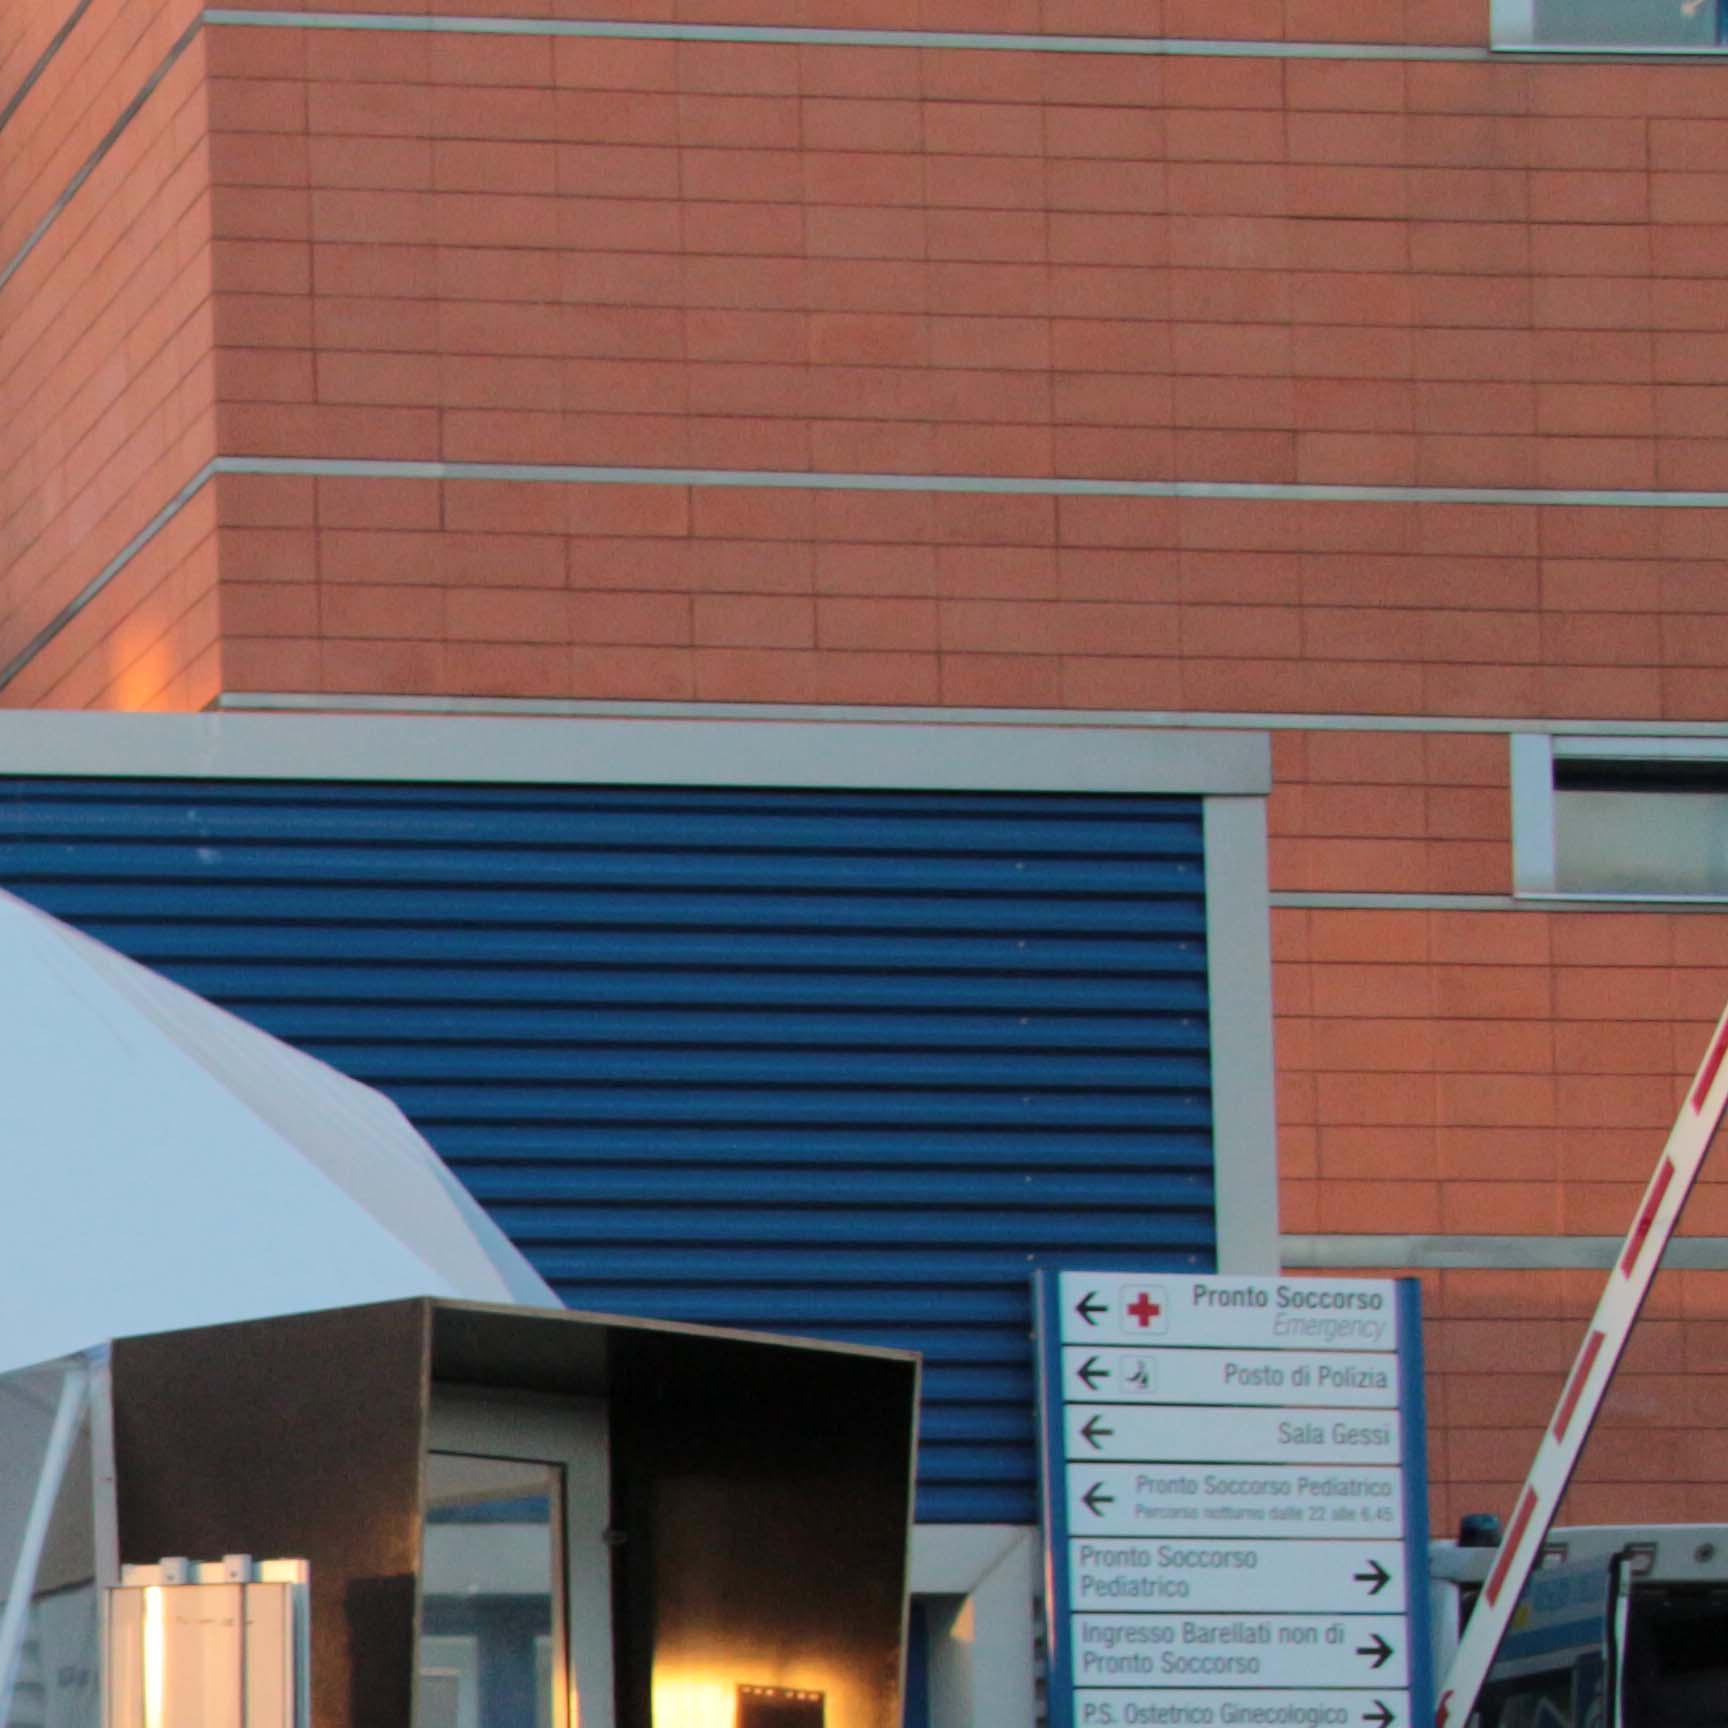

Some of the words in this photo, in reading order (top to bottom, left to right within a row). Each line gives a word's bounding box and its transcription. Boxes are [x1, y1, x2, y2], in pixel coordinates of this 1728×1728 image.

[1193, 1284, 1269, 1307] Pronto
[1276, 1285, 1384, 1310] Soccorso
[1272, 1311, 1387, 1342] Emergency
[1224, 1363, 1284, 1386] Posto
[1291, 1366, 1311, 1387] di
[1318, 1365, 1388, 1389] Polizia
[1278, 1422, 1325, 1445] Sala
[1332, 1423, 1390, 1445] Gessi
[1136, 1474, 1199, 1495] Pronto
[1204, 1475, 1291, 1496] Soccorso
[1297, 1476, 1392, 1497] Pediatrico
[1308, 1506, 1326, 1521] 22
[1080, 1545, 1151, 1568] Pronto
[1157, 1545, 1258, 1568] Soccorso
[1080, 1574, 1189, 1598] Pediatrico
[1082, 1621, 1175, 1646] Ingresso
[1182, 1621, 1271, 1644] Barellati
[1279, 1627, 1318, 1644] non
[1325, 1623, 1345, 1644] di
[1082, 1650, 1153, 1674] Pronto
[1161, 1651, 1260, 1675] Soccorso
[1123, 1702, 1215, 1726] Ostetrico
